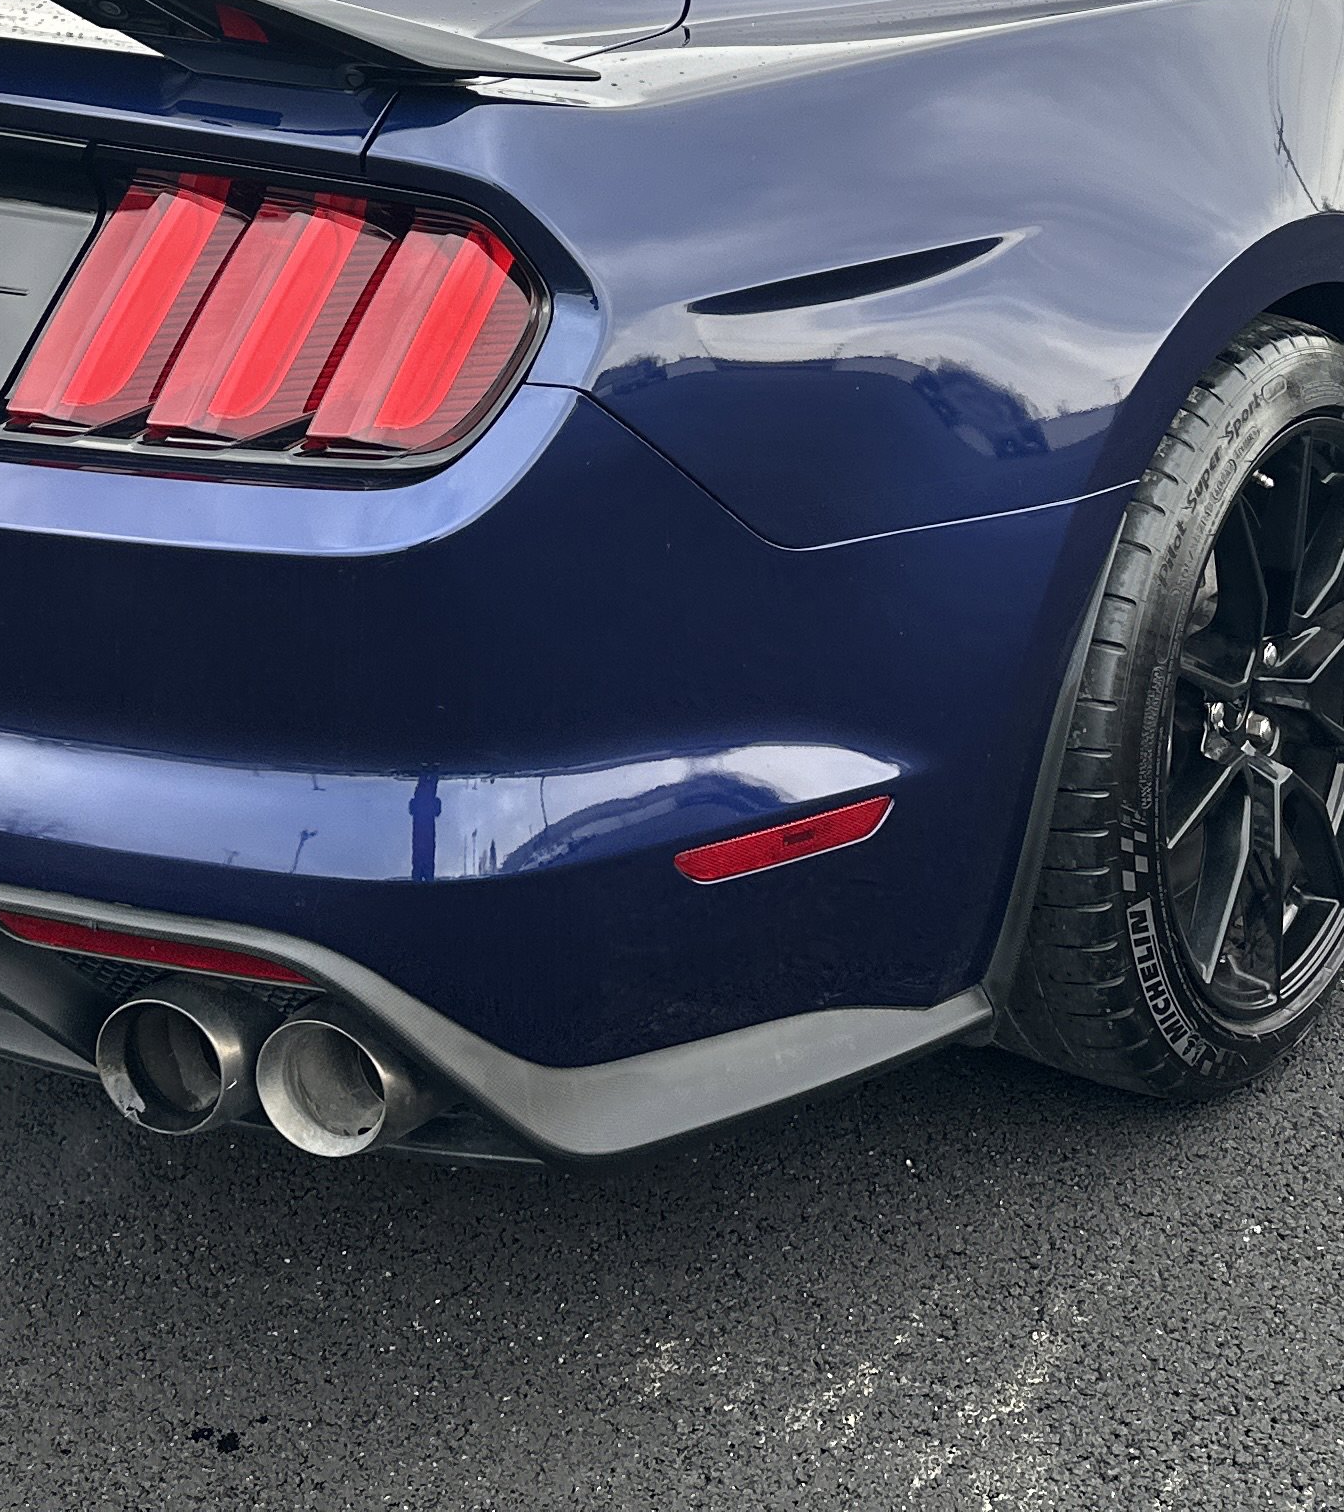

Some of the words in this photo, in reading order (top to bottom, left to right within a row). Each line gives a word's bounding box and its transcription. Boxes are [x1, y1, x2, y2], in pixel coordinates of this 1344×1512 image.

[1181, 445, 1224, 513] Super
[1217, 393, 1263, 444] Sport
[1128, 908, 1190, 1047] MICHELIN
